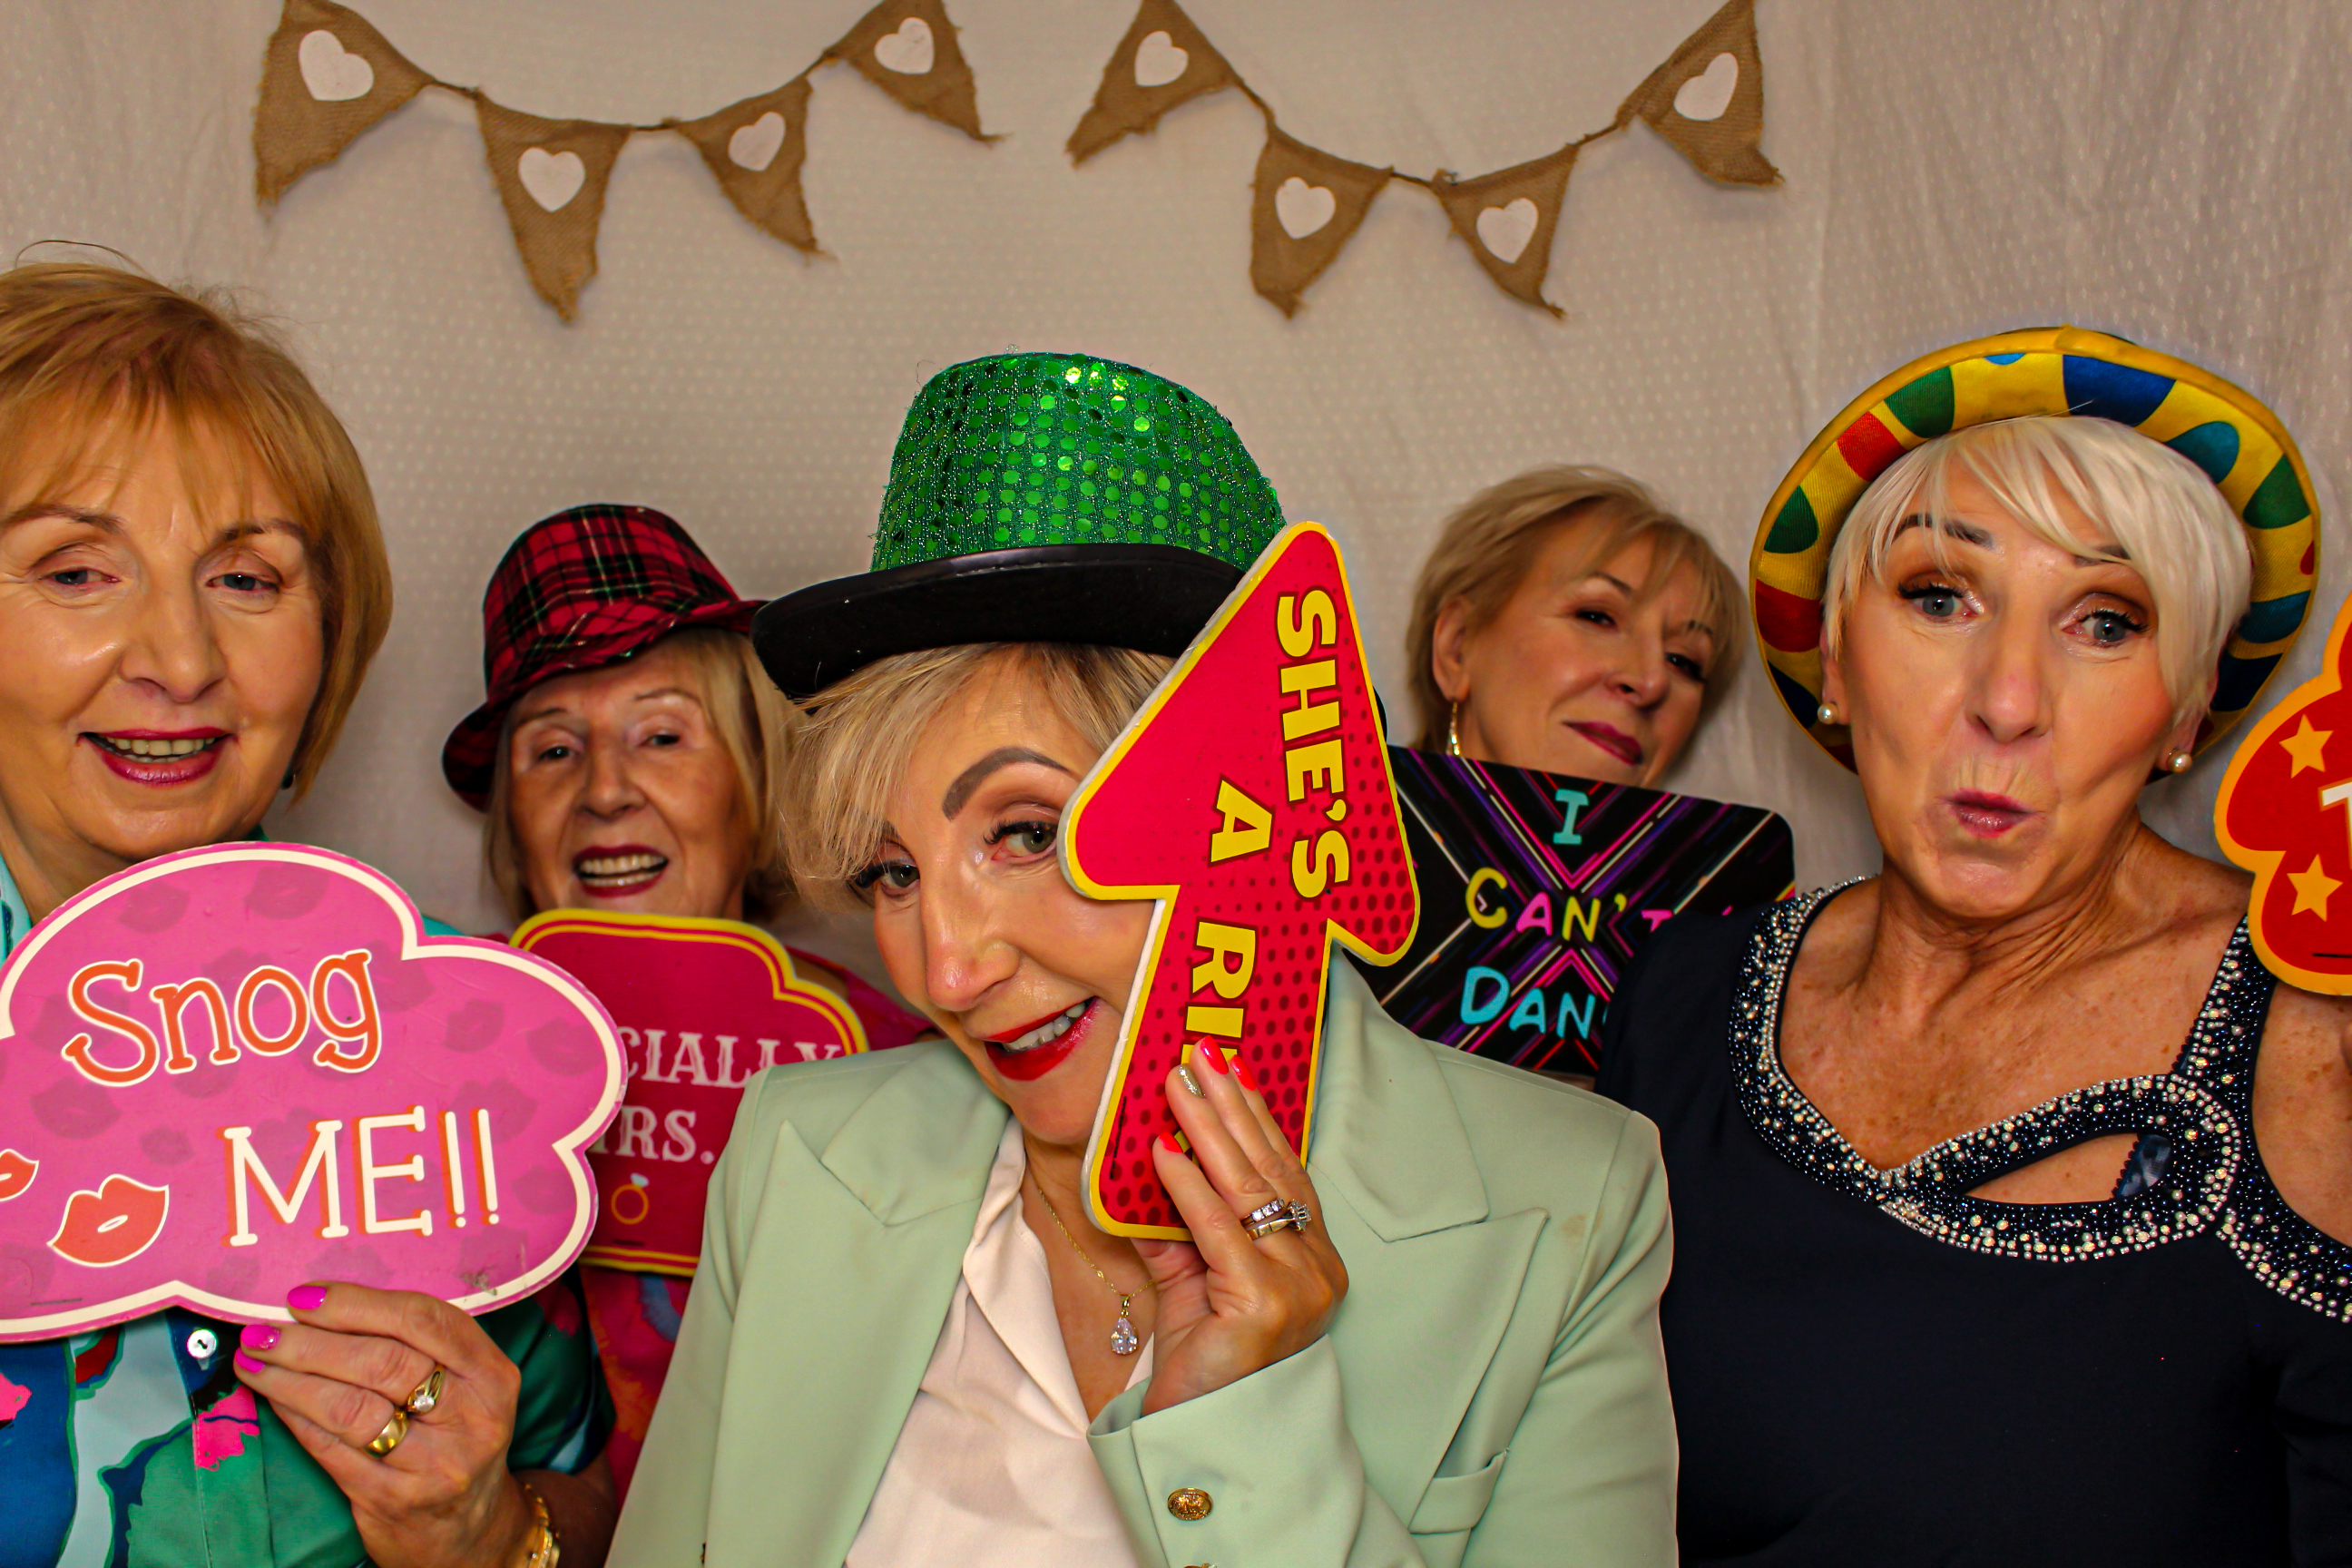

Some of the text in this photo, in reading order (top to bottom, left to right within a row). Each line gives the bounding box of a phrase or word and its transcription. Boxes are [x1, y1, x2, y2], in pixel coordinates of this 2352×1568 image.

[1275, 587, 1351, 900] SHE'S
[1209, 778, 1274, 865] A
[1552, 788, 1590, 846] I
[61, 948, 382, 1086] Snog
[1459, 965, 1609, 1040] DAN
[220, 1104, 501, 1247] ME!!
[587, 1104, 716, 1165] RS.
